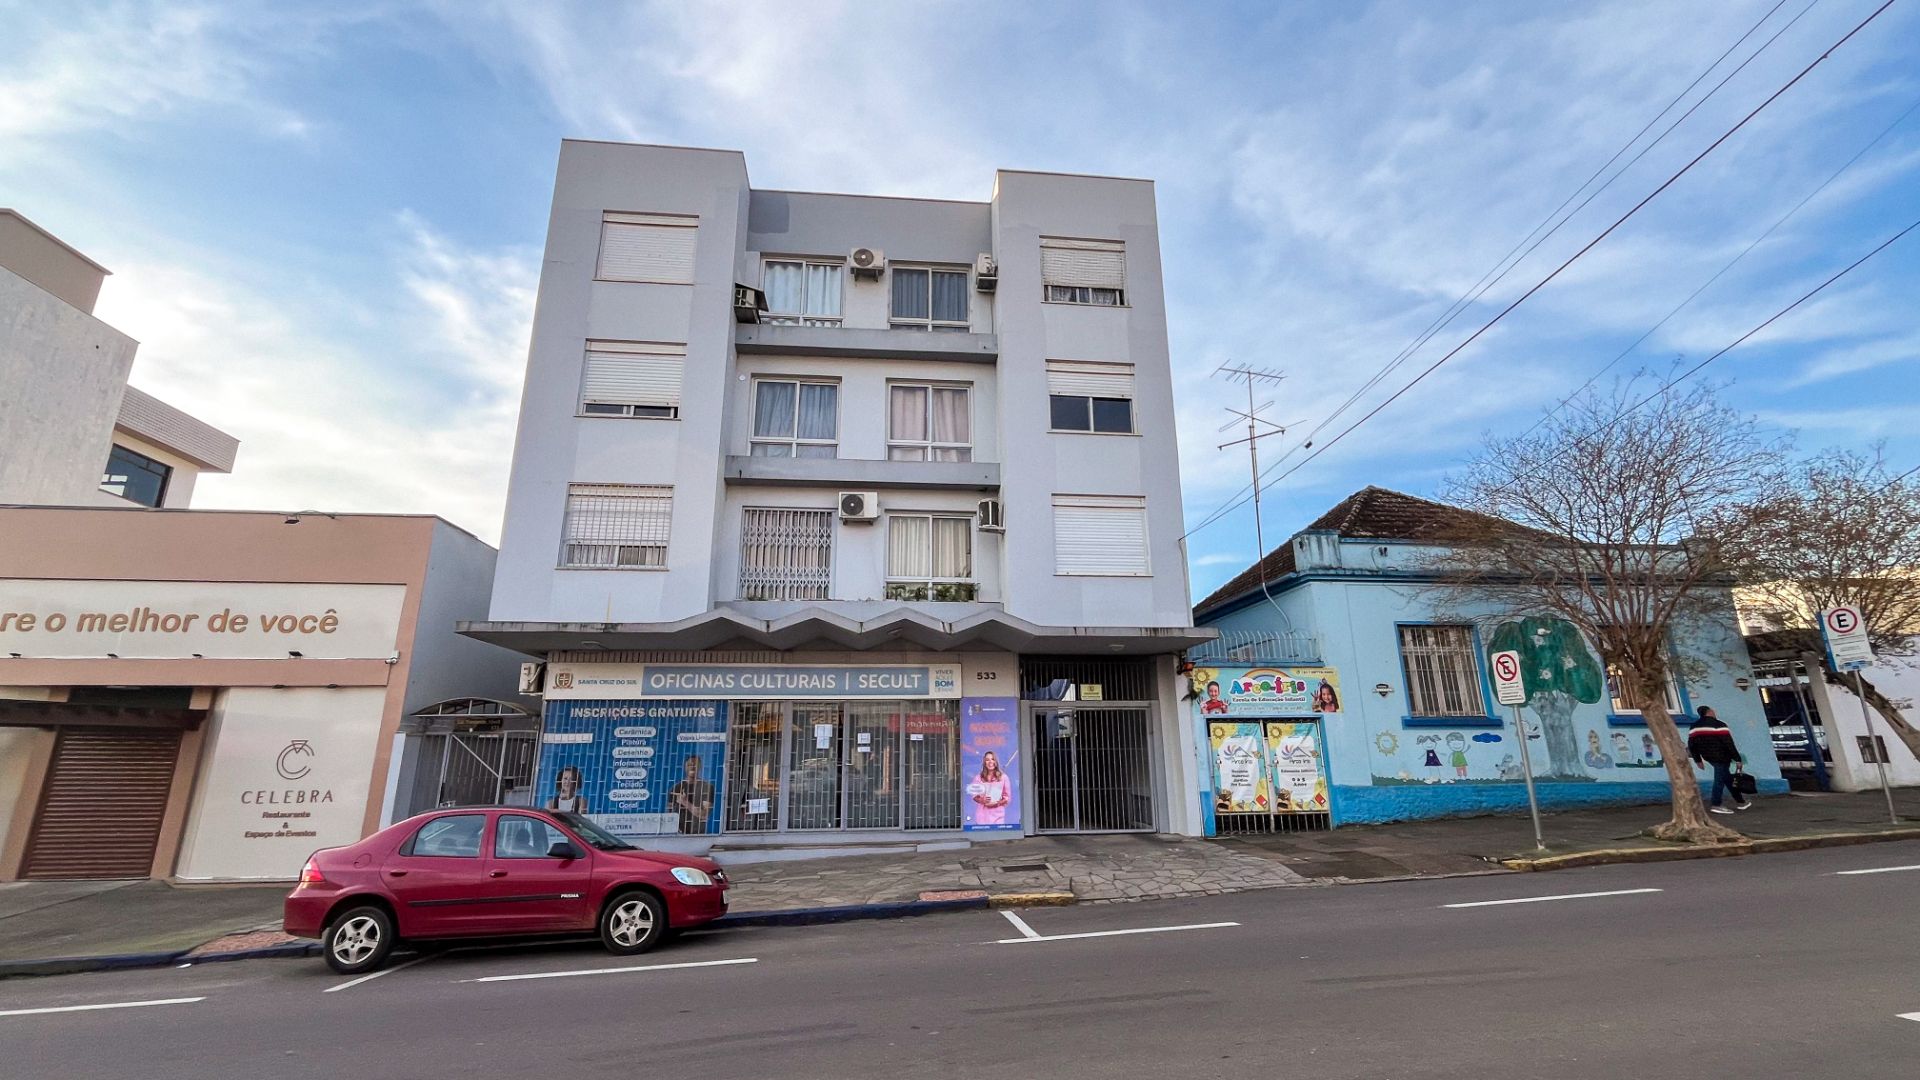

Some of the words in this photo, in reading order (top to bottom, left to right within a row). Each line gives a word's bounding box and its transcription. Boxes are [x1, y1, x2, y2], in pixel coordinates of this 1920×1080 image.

[45, 613, 66, 633] o
[76, 607, 199, 633] melhor
[207, 608, 249, 633] de
[260, 608, 339, 634] você
[1836, 613, 1849, 628] E
[650, 673, 735, 689] OFICINAS
[740, 673, 836, 689] CULTURAIS
[858, 674, 922, 689] SECULT
[976, 671, 997, 681] 533
[934, 680, 954, 688] BOM
[570, 705, 645, 720] INSCRIÇÕES
[648, 707, 715, 718] GRATUITAS
[241, 790, 333, 804] CELEBRA
[612, 791, 647, 799] Saxofone
[244, 830, 273, 838] Espaço
[275, 829, 285, 837] de
[286, 829, 316, 837] Eventos
